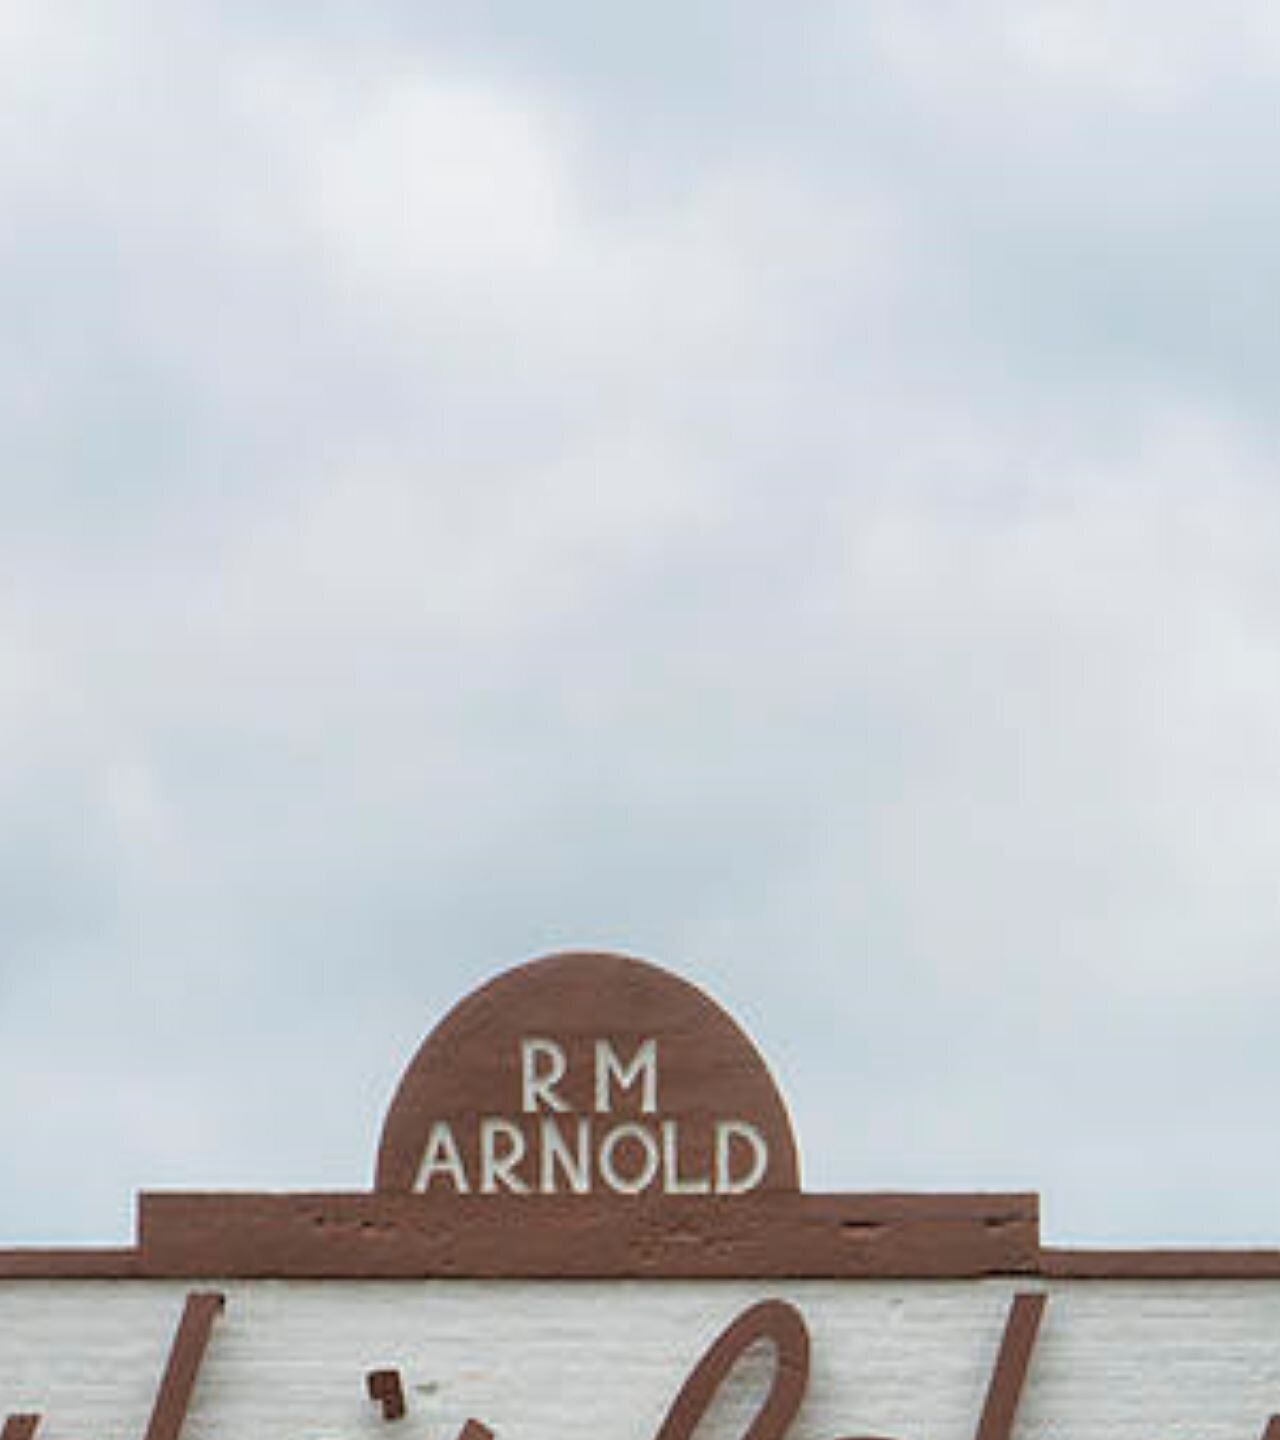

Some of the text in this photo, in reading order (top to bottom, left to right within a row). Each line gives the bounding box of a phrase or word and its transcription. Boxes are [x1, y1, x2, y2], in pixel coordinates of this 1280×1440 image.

[521, 1038, 658, 1114] R M
[412, 1117, 769, 1195] ARNOLD
